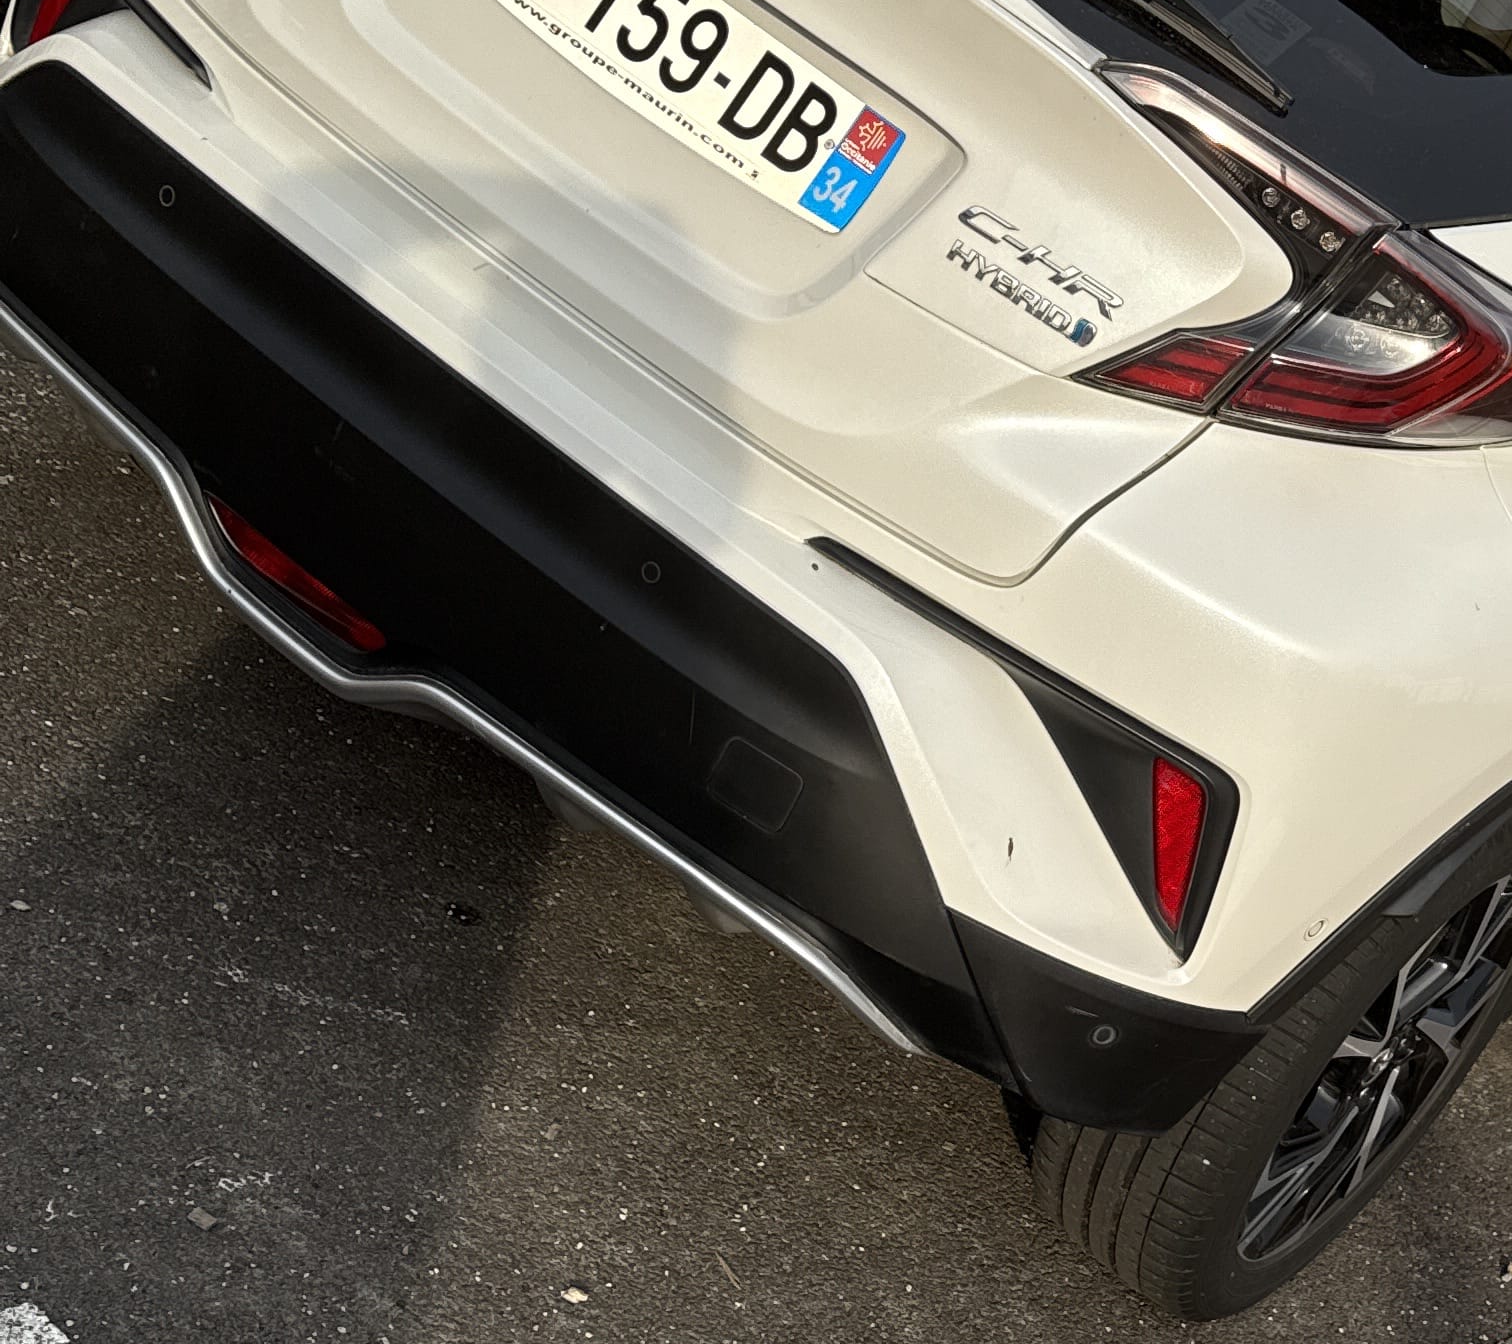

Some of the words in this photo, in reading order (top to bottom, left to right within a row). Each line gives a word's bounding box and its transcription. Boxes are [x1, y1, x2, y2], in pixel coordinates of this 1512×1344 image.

[812, 166, 859, 213] 34
[946, 239, 1073, 335] HYBRID
[958, 205, 1125, 321] C-HR
